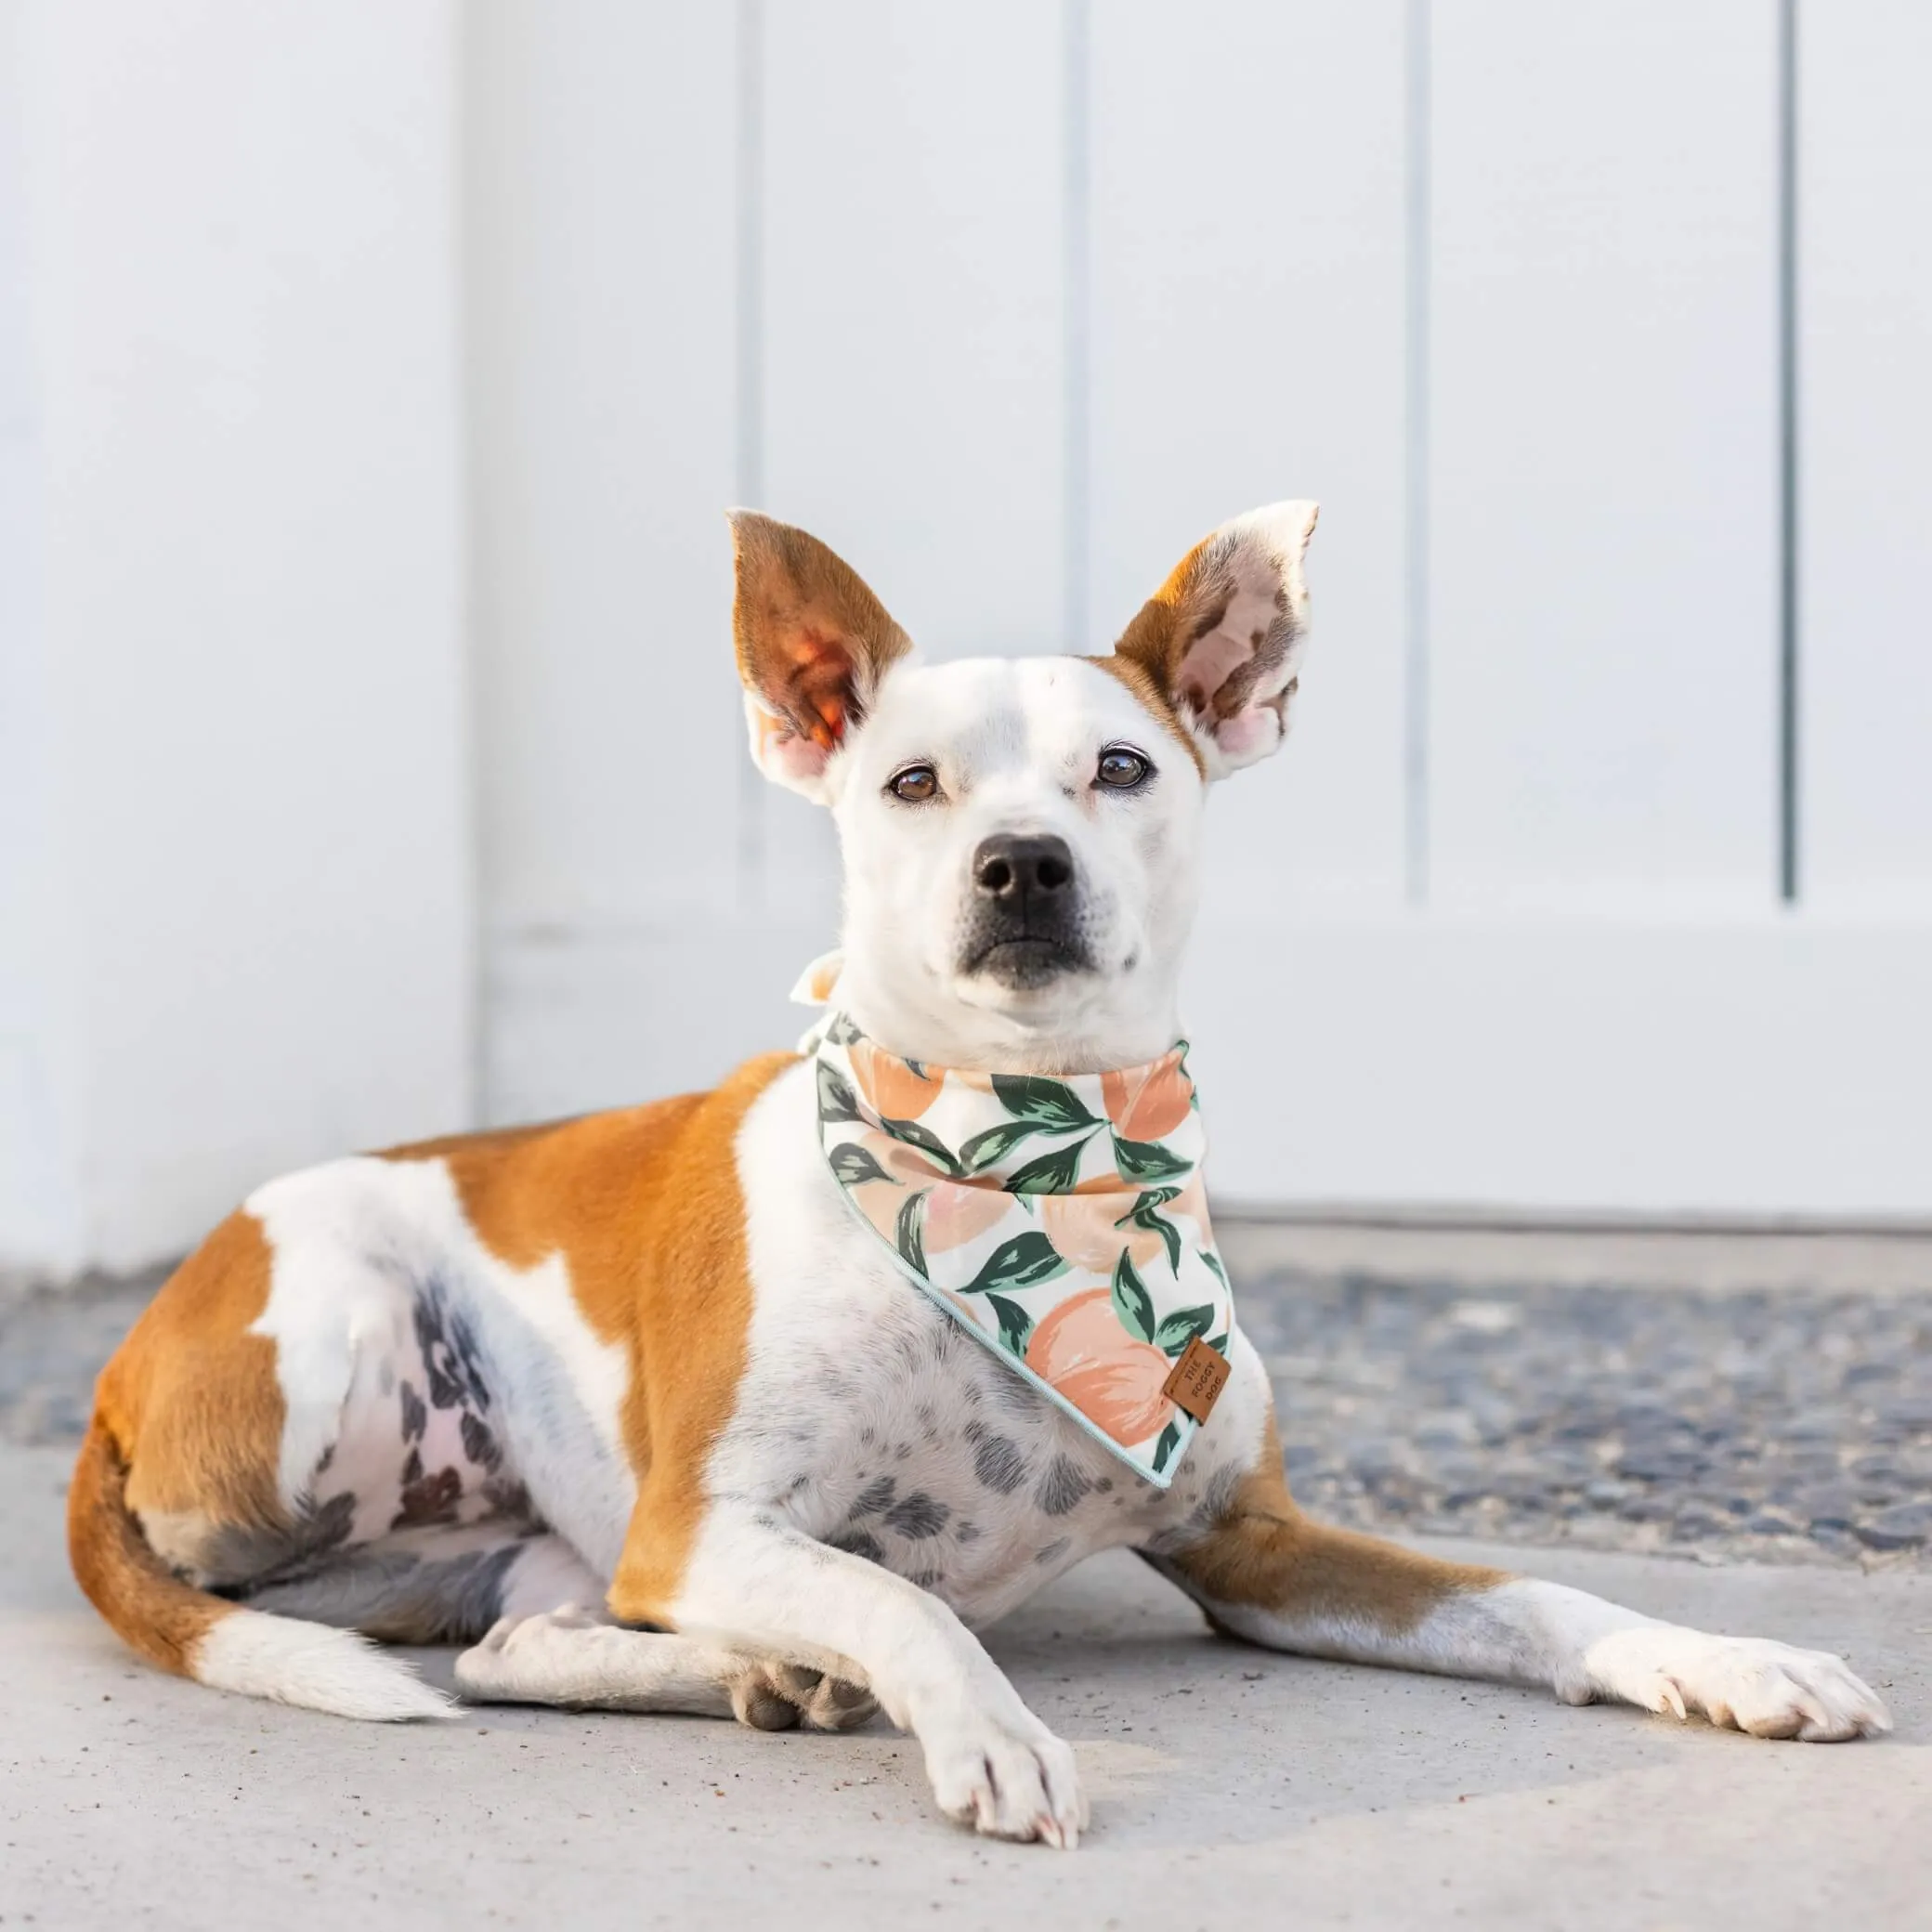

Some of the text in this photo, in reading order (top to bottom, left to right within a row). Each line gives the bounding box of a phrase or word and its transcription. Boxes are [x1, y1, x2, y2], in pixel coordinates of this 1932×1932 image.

[1184, 1360, 1201, 1380] THE
[1191, 1361, 1215, 1398] FOGGY
[1205, 1376, 1221, 1401] DOG
